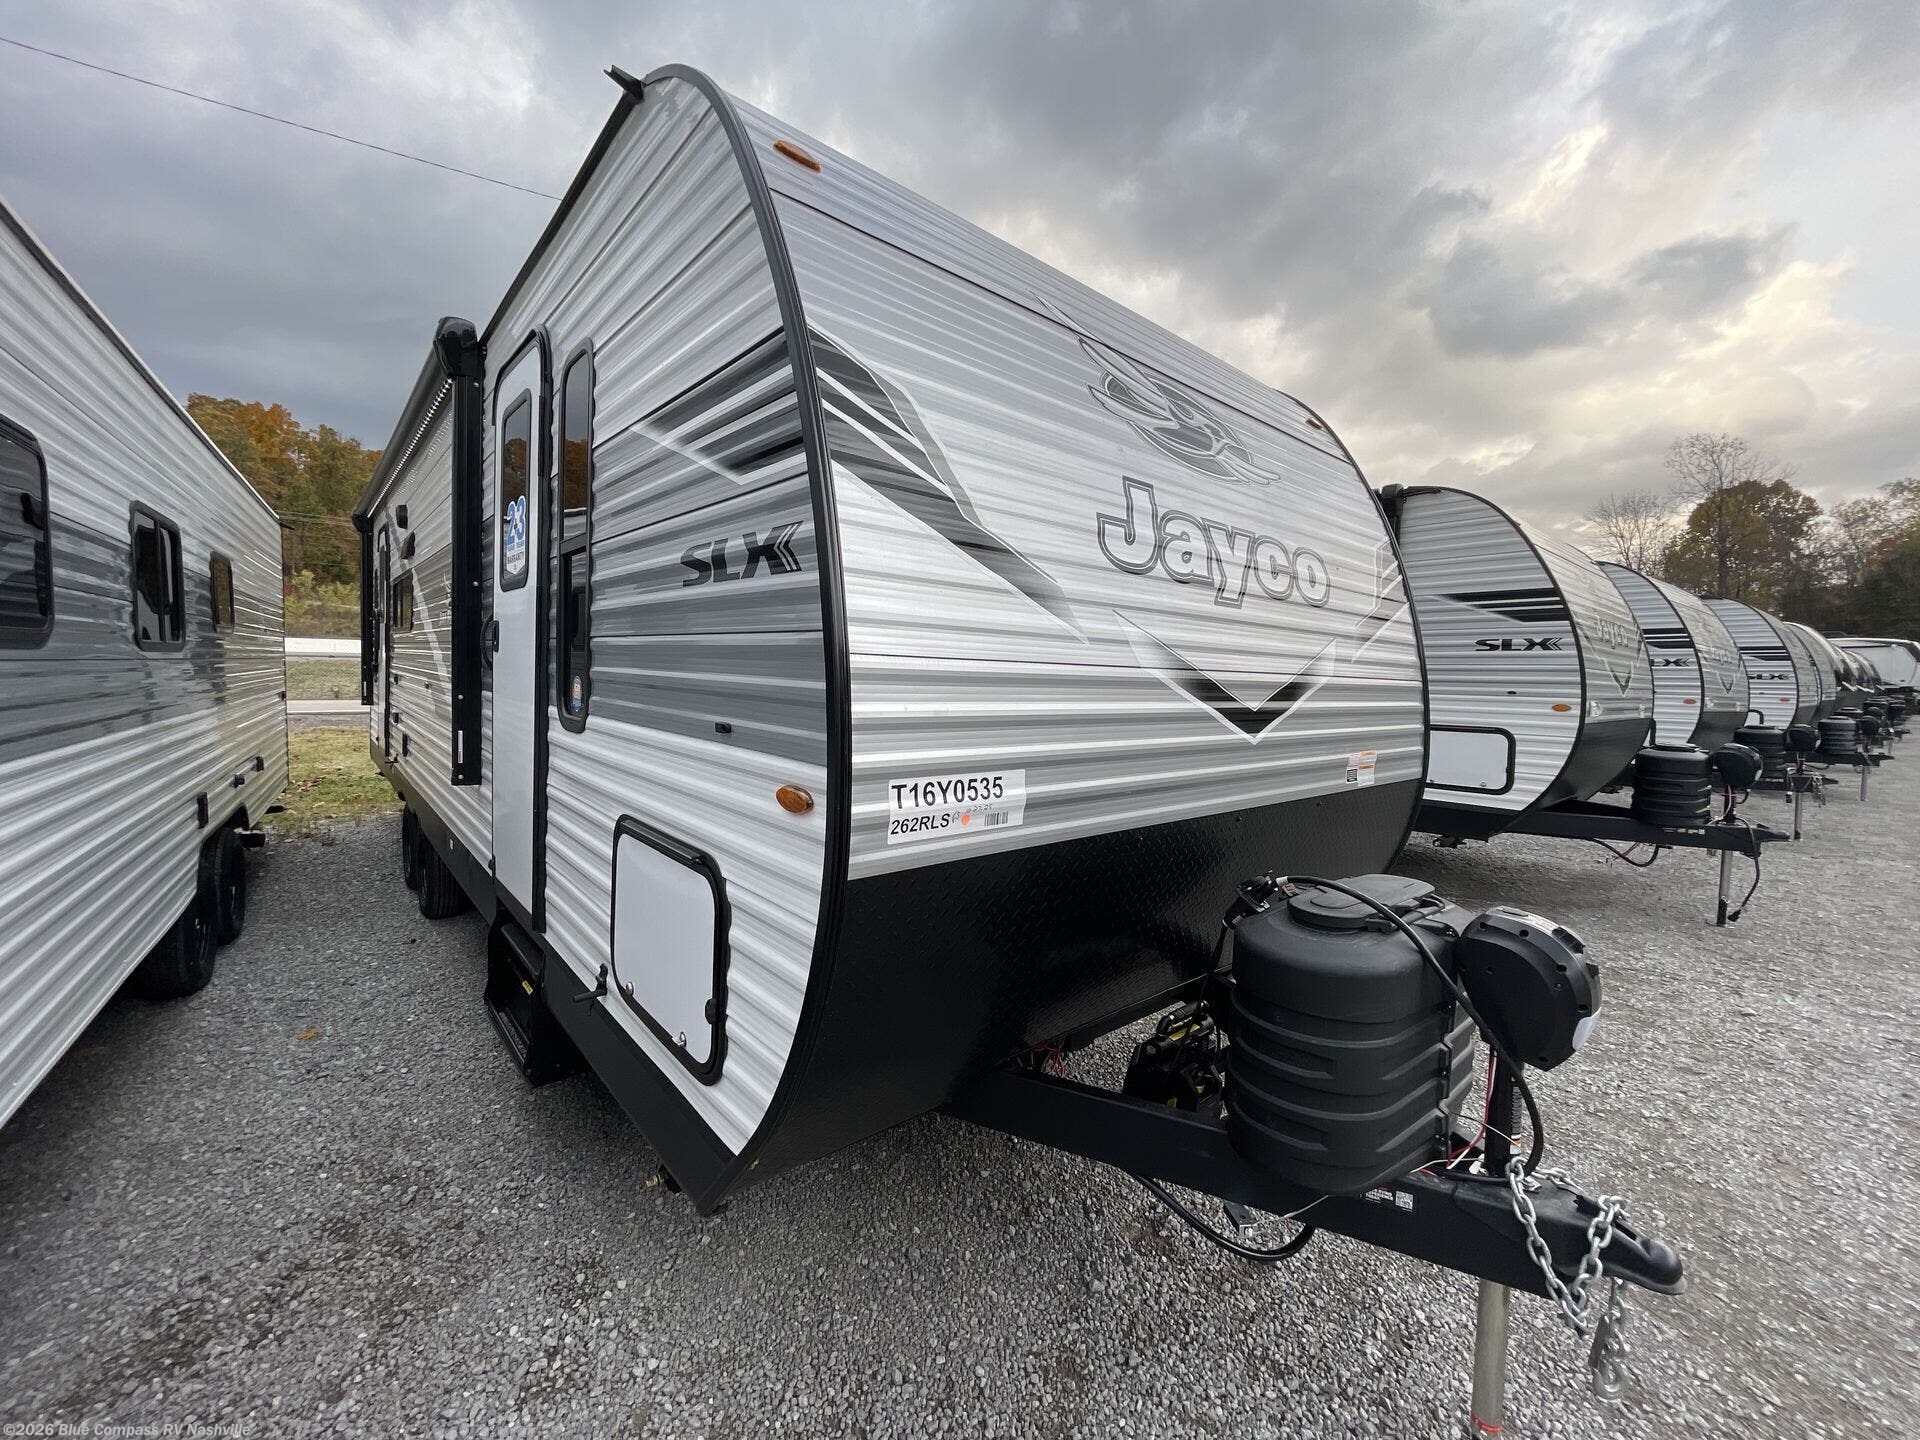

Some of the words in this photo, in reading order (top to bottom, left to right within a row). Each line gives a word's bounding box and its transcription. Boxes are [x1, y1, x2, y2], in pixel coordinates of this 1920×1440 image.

[680, 520, 804, 587] SLX
[1096, 475, 1330, 609] Jayco
[1475, 637, 1563, 651] SLX
[1649, 658, 1689, 667] LX
[891, 776, 1003, 809] T16Y0535
[890, 813, 951, 835] 262RLS
